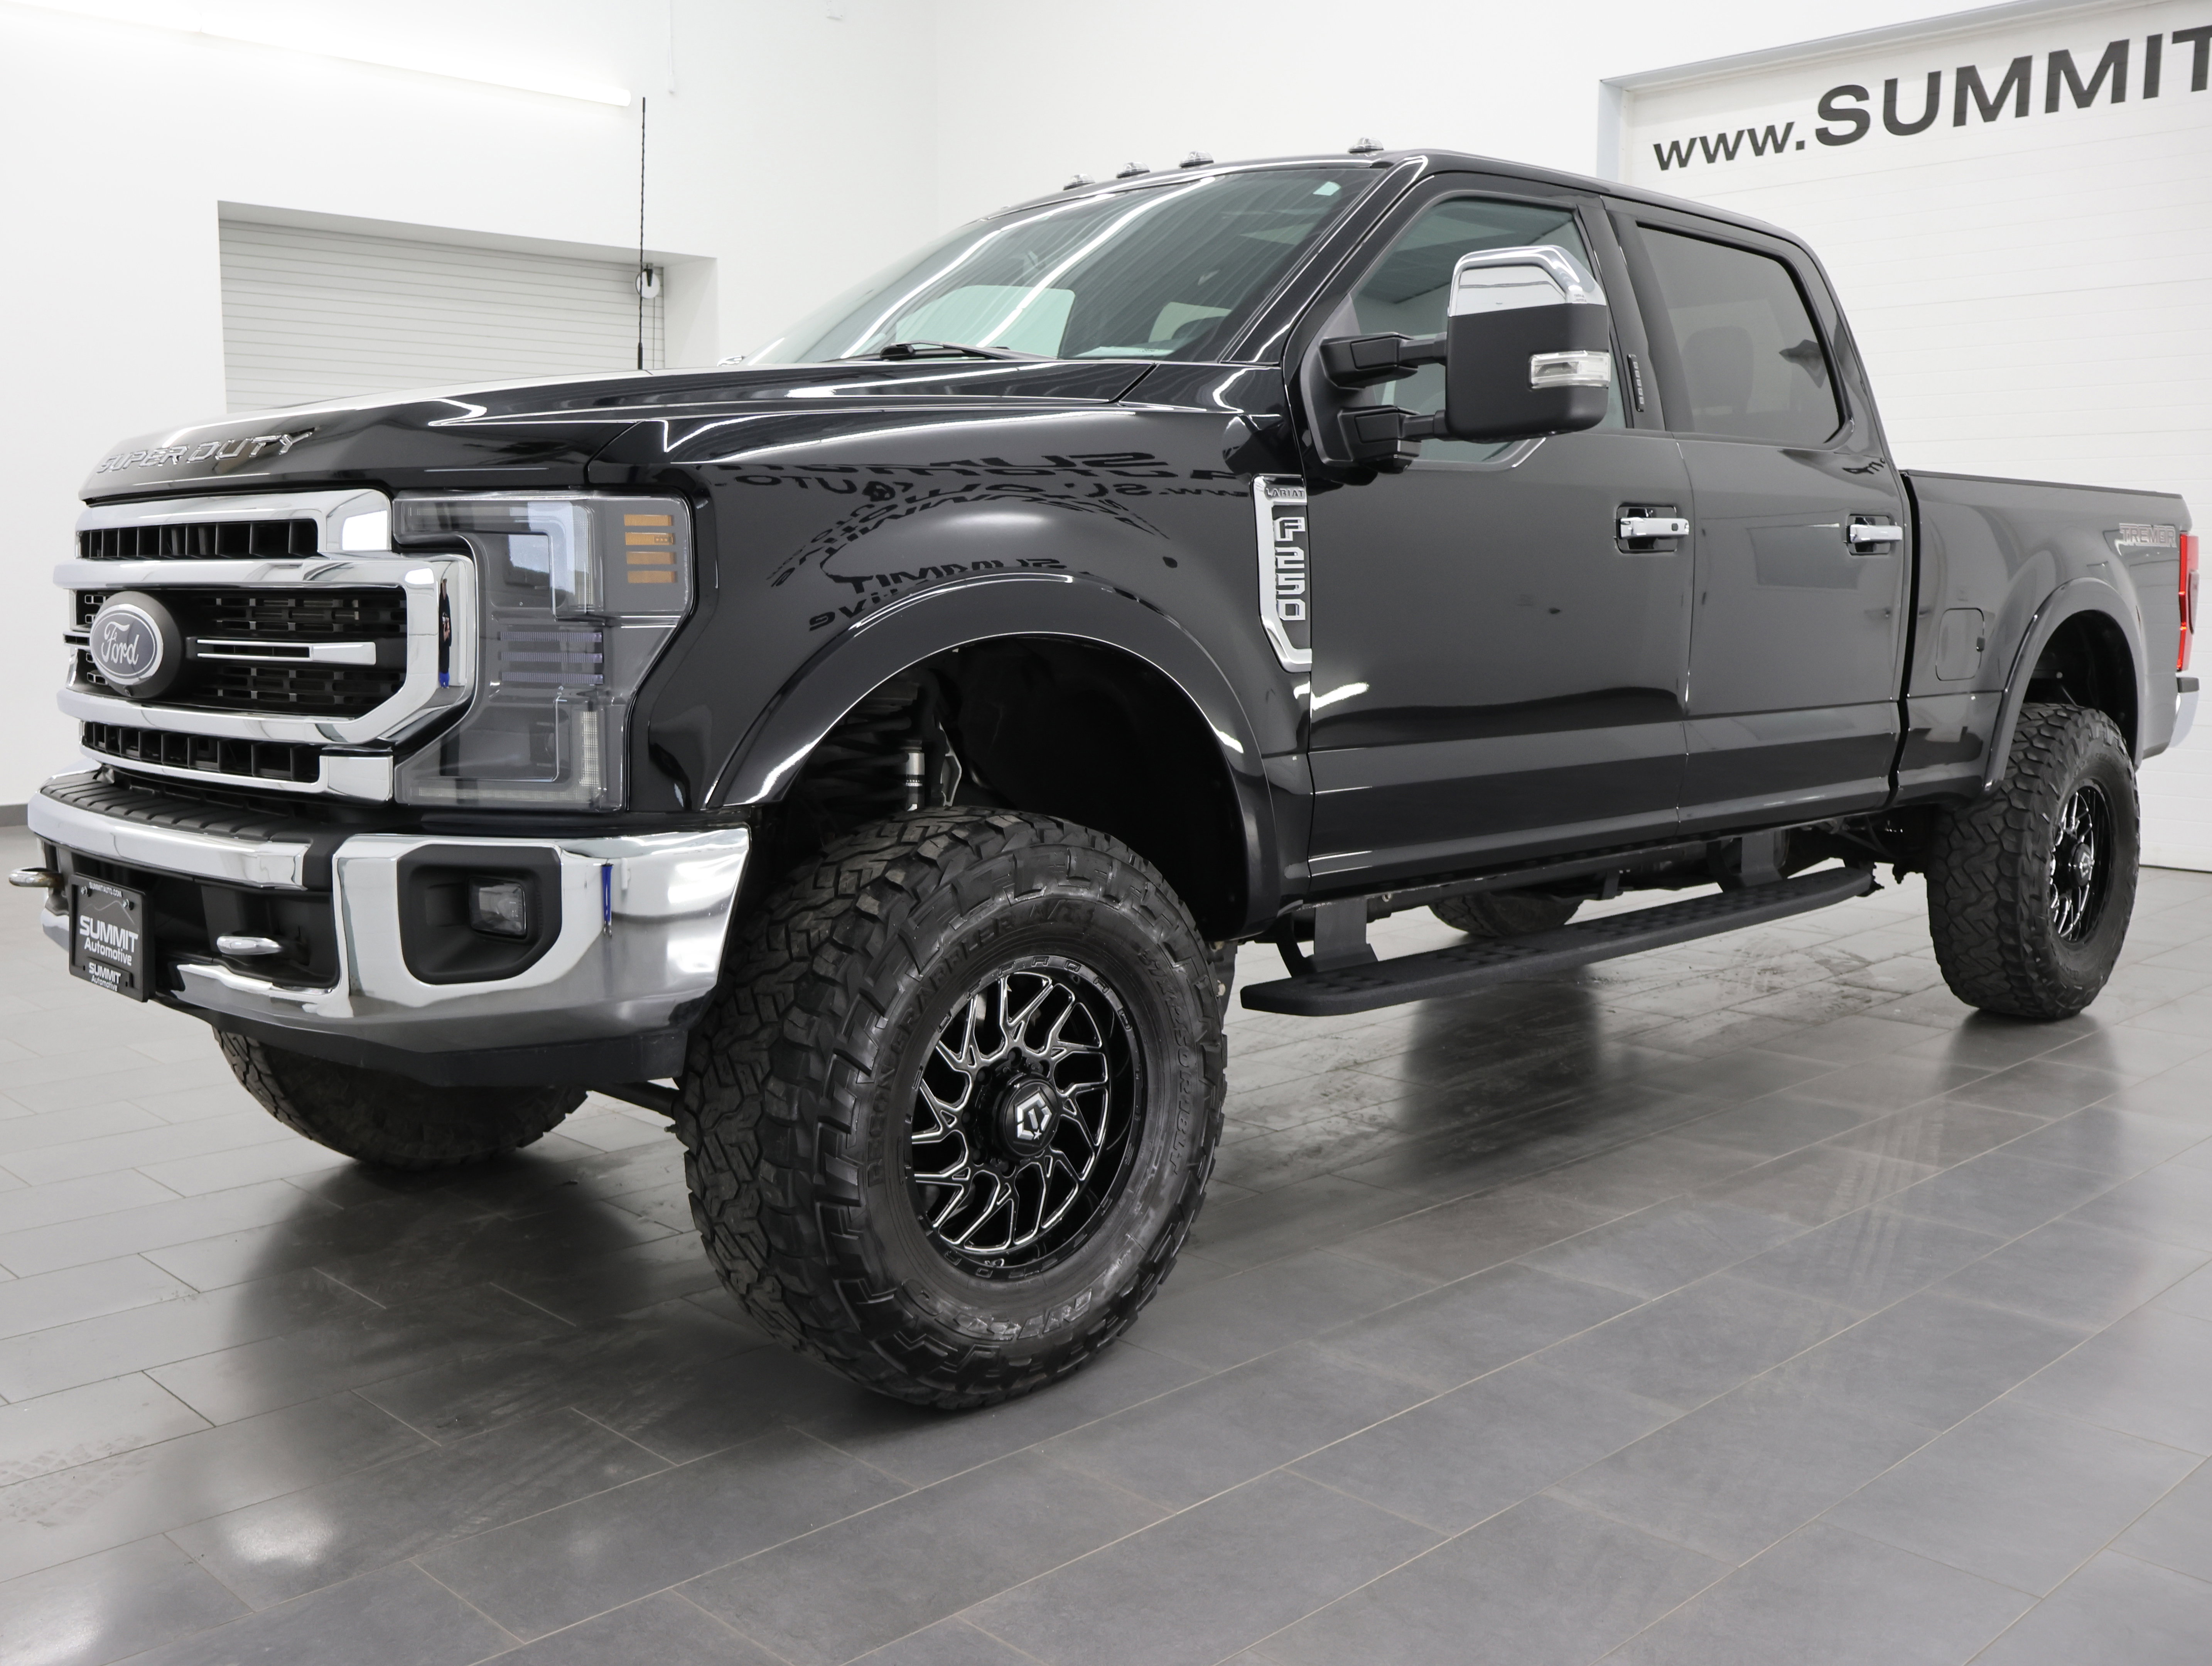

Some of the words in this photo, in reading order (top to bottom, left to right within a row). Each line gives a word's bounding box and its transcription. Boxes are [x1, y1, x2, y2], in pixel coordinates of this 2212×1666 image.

[96, 444, 189, 474] SUPER
[188, 432, 313, 463] DUTY
[1265, 487, 1305, 498] LARIAT
[101, 621, 140, 665] Ford
[80, 915, 138, 953] SUMMIT
[84, 937, 132, 966] Automotive
[89, 962, 121, 984] SUMMIT
[91, 975, 118, 992] Automotive
